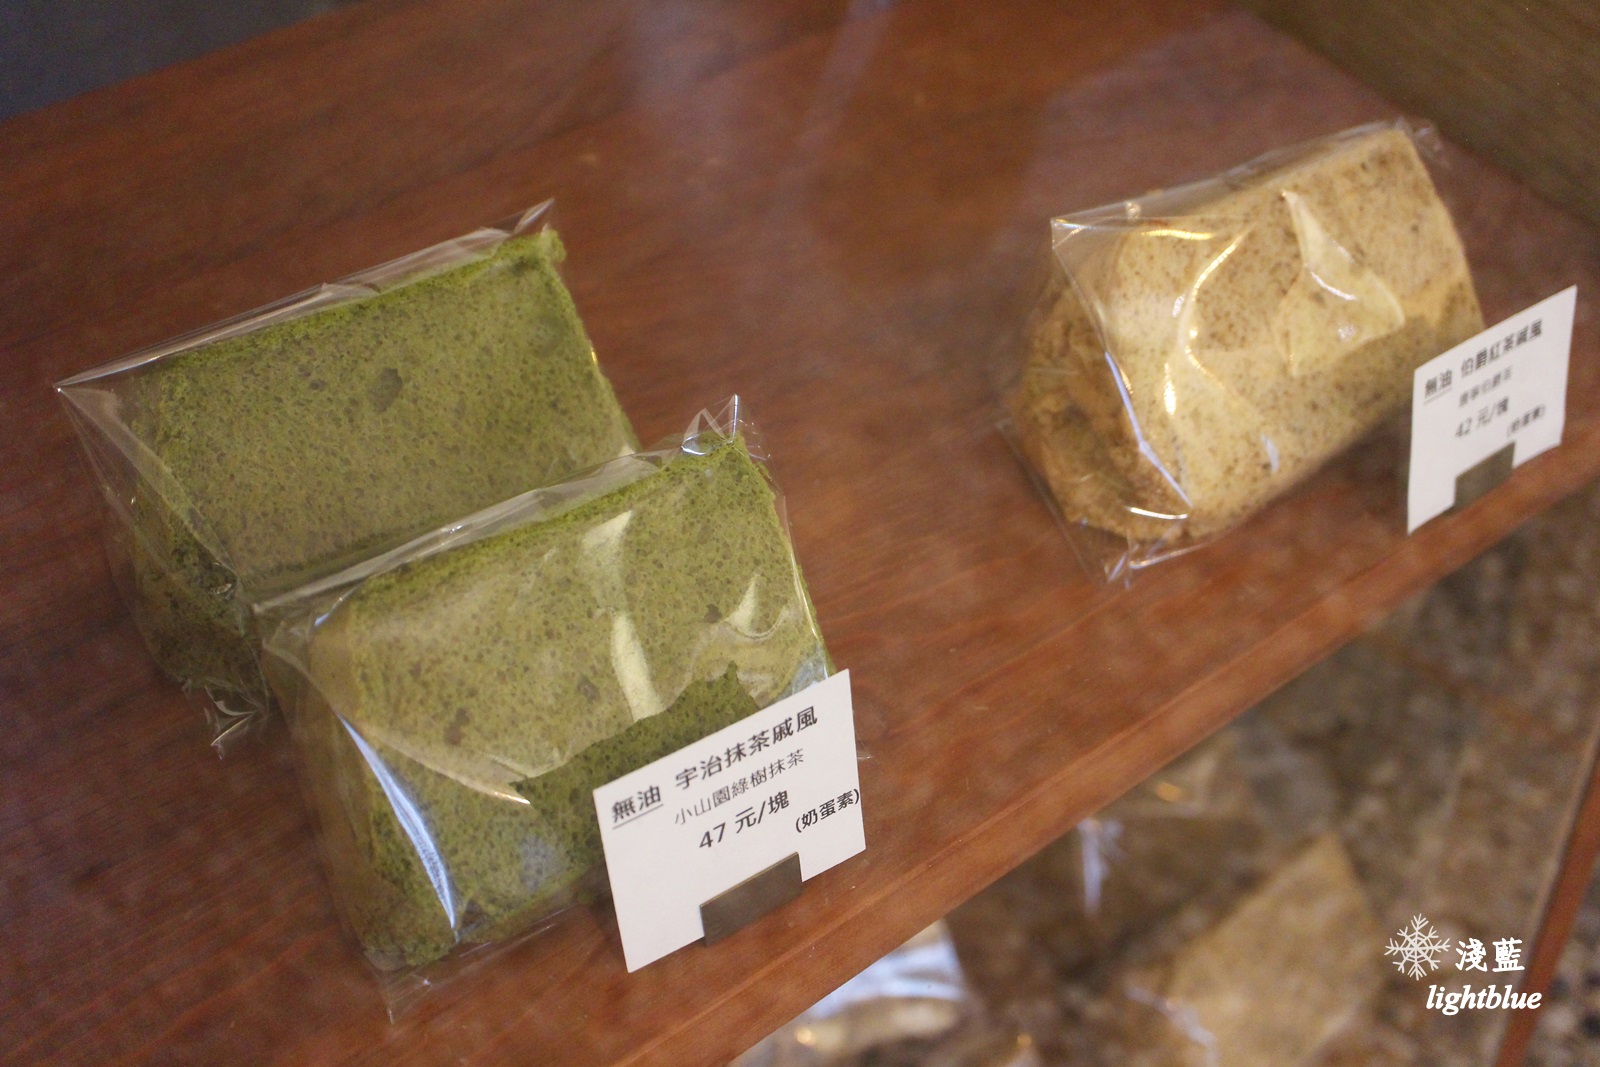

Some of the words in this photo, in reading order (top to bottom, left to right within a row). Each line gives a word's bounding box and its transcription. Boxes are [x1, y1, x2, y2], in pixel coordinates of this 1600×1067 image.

[1425, 369, 1453, 398] 無油
[1461, 319, 1542, 377] 伯爵紅茶戚風
[1455, 420, 1472, 438] 42
[611, 785, 662, 823] 無油
[675, 706, 817, 790] 宇治抹茶戚風
[674, 749, 804, 825] 小山園綠樹抹茶
[699, 821, 726, 849] 47
[735, 790, 789, 833] 元/塊
[795, 789, 860, 833] (奶蛋素)
